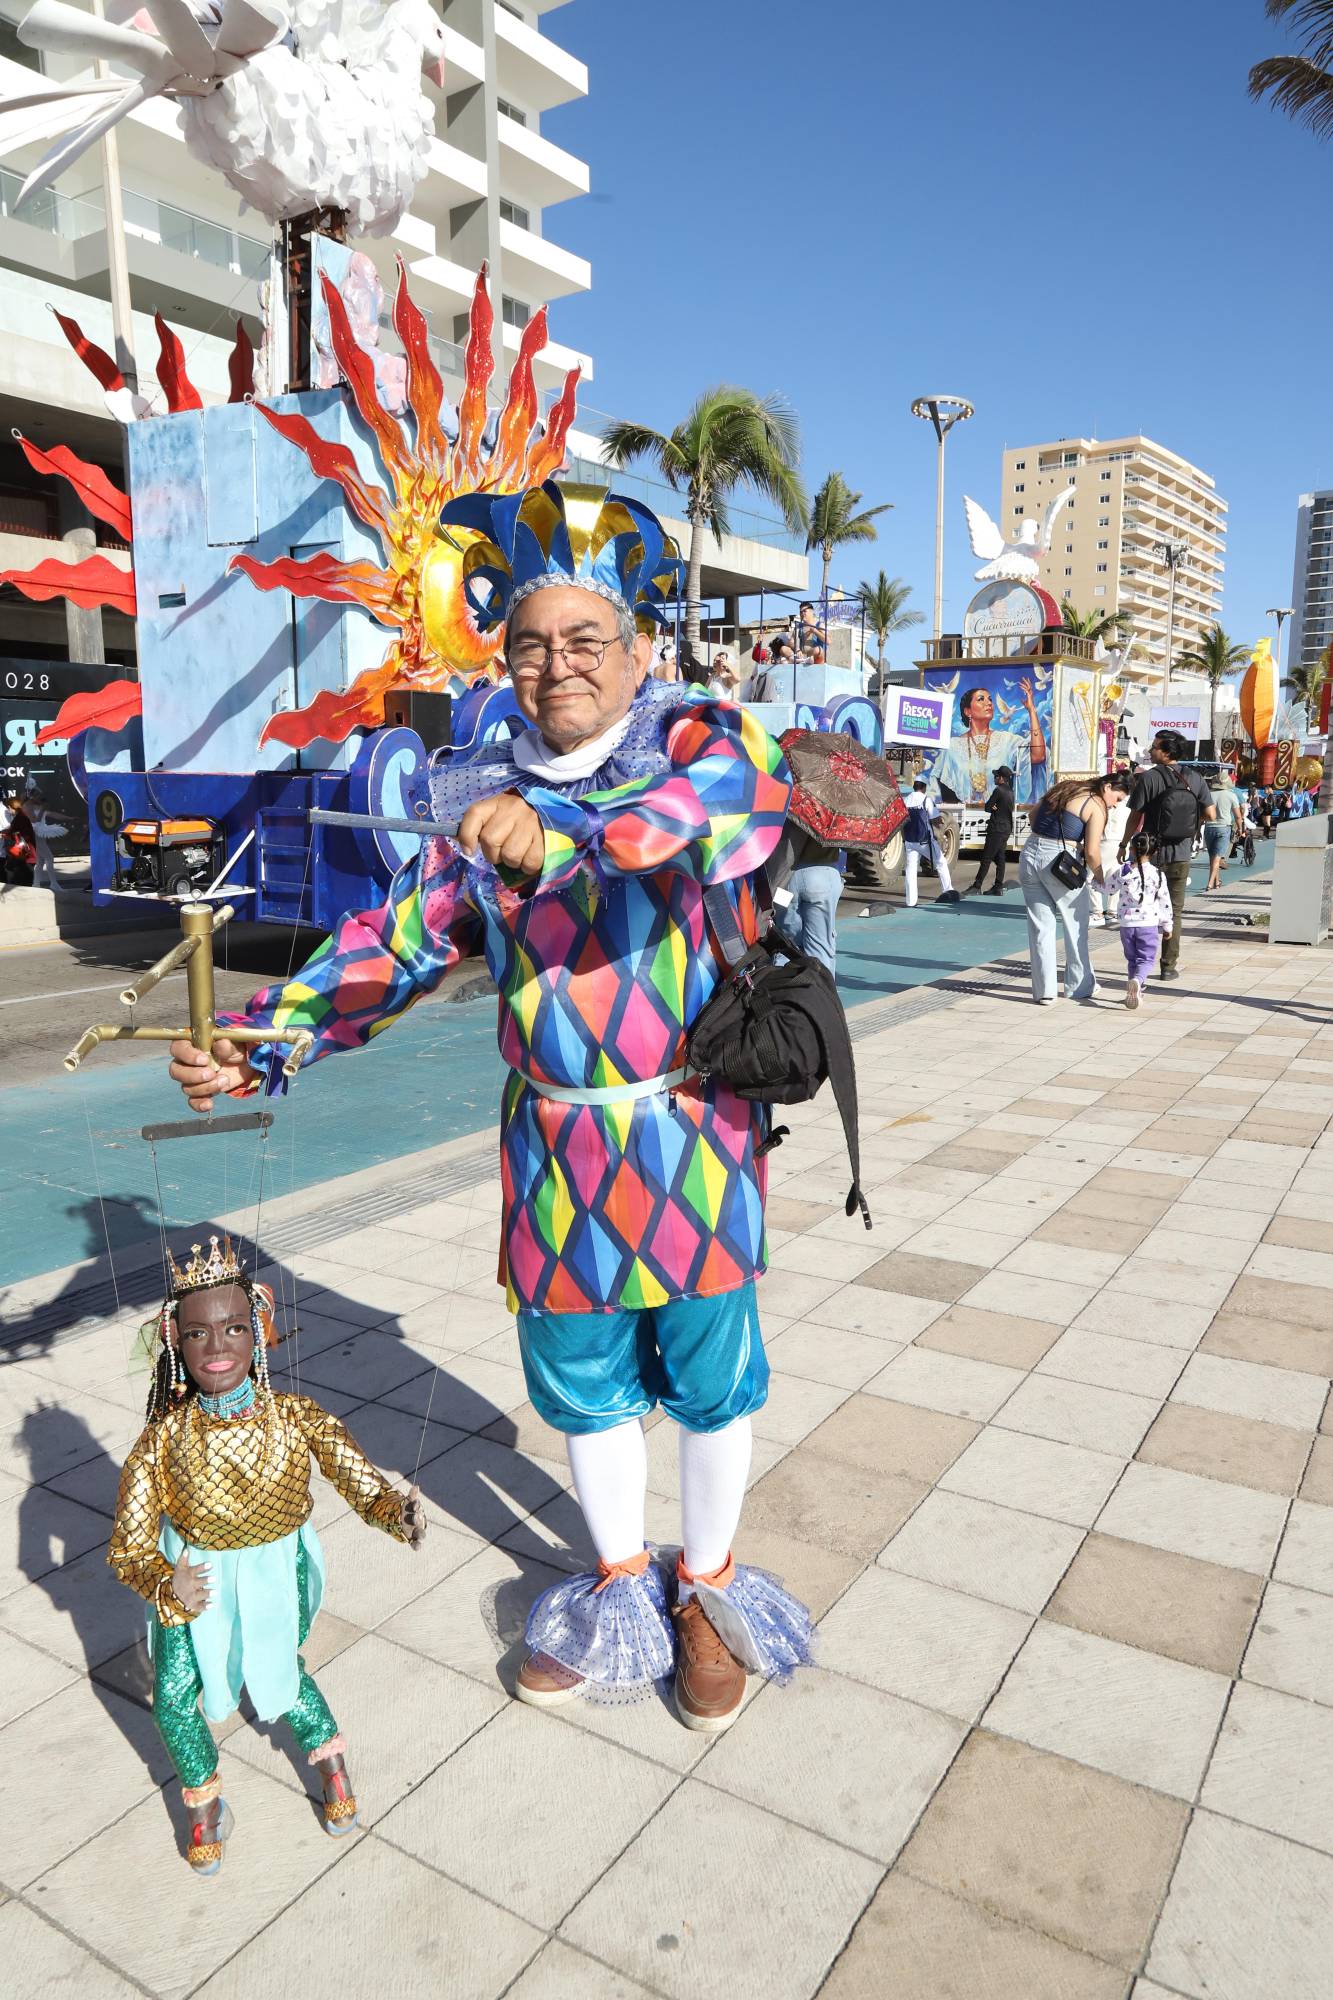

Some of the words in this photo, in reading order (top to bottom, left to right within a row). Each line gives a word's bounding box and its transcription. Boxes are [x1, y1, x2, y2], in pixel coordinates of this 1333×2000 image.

[902, 700, 933, 719] FRESCA
[1150, 720, 1199, 729] NOROESTE
[102, 795, 117, 829] 9
